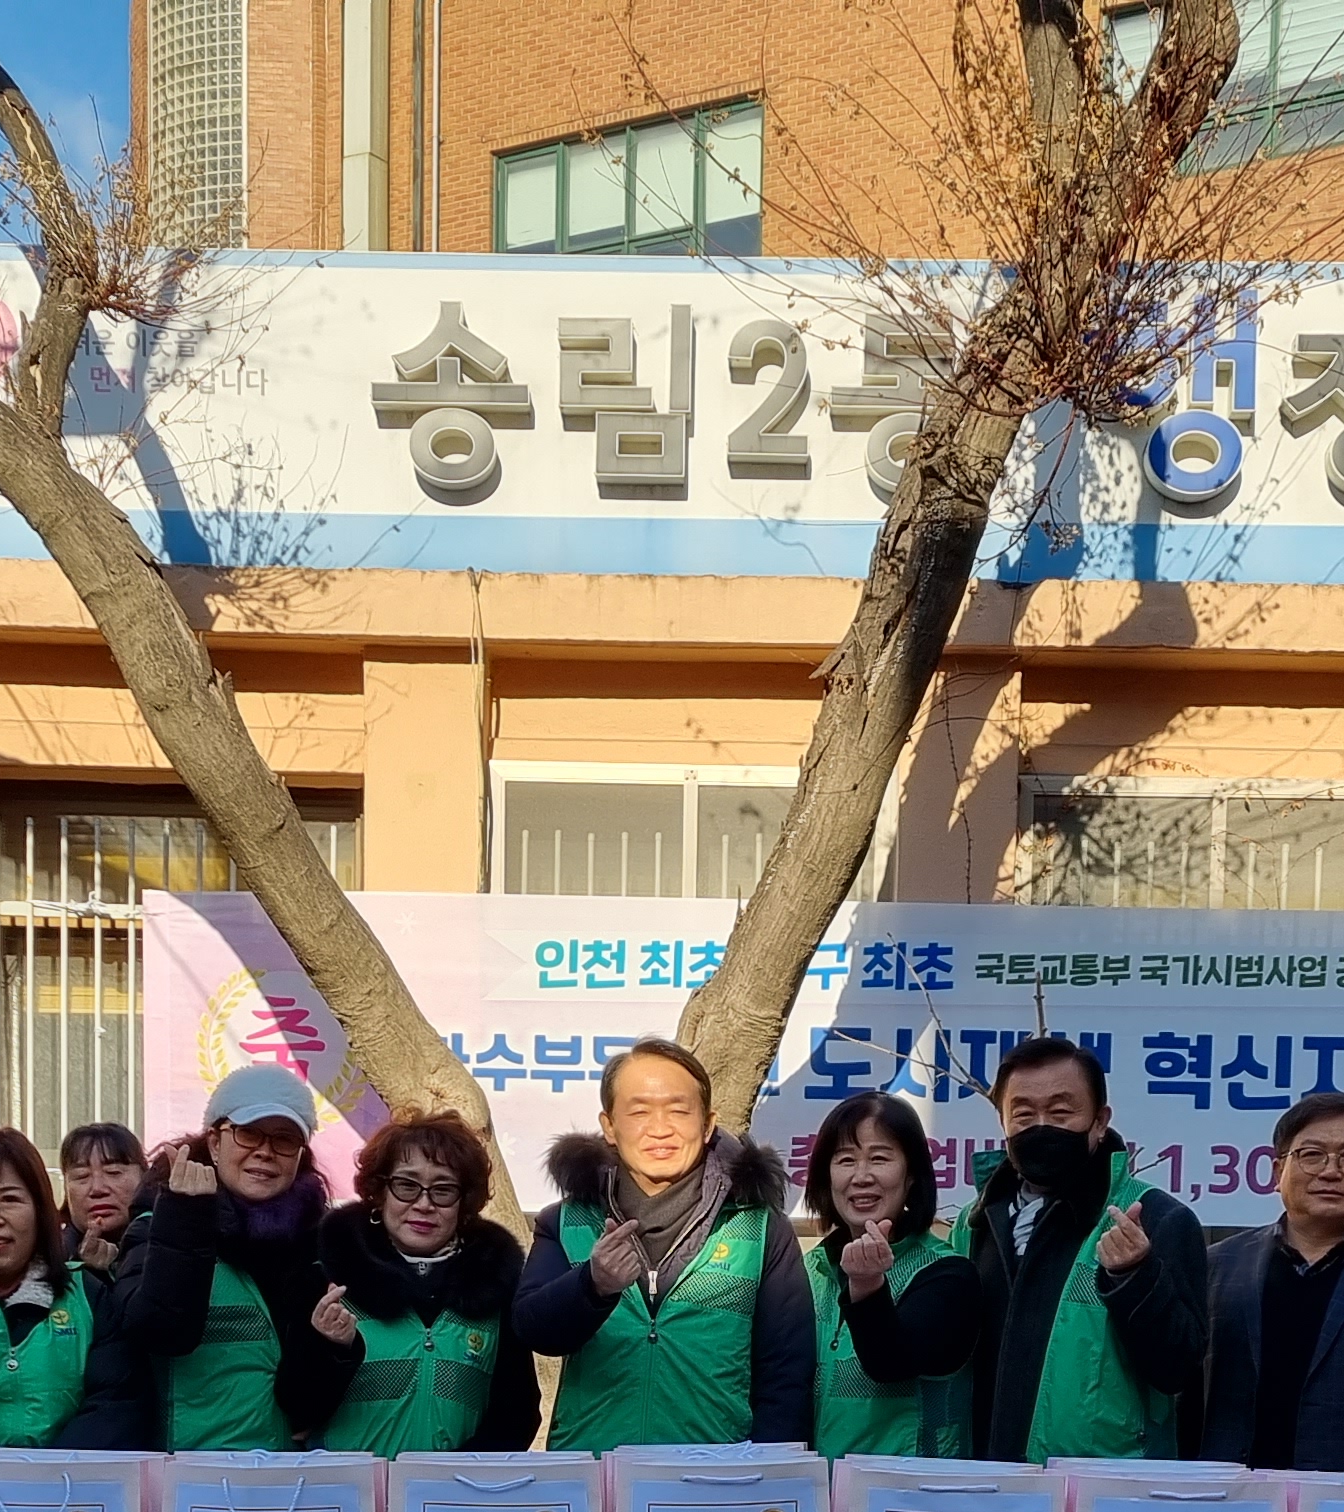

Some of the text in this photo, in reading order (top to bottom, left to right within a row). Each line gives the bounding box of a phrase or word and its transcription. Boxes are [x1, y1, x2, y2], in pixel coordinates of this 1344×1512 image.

[126, 328, 198, 357] 이웃을
[90, 366, 269, 395] 먼저 찾아갑니다
[535, 940, 626, 988] 인천
[639, 940, 728, 989] 최초
[806, 942, 849, 990] 구
[861, 941, 954, 991] 최초
[975, 953, 1131, 987] 국토교통부
[1139, 954, 1327, 988] 국가시범사업
[442, 1033, 633, 1093] 수부
